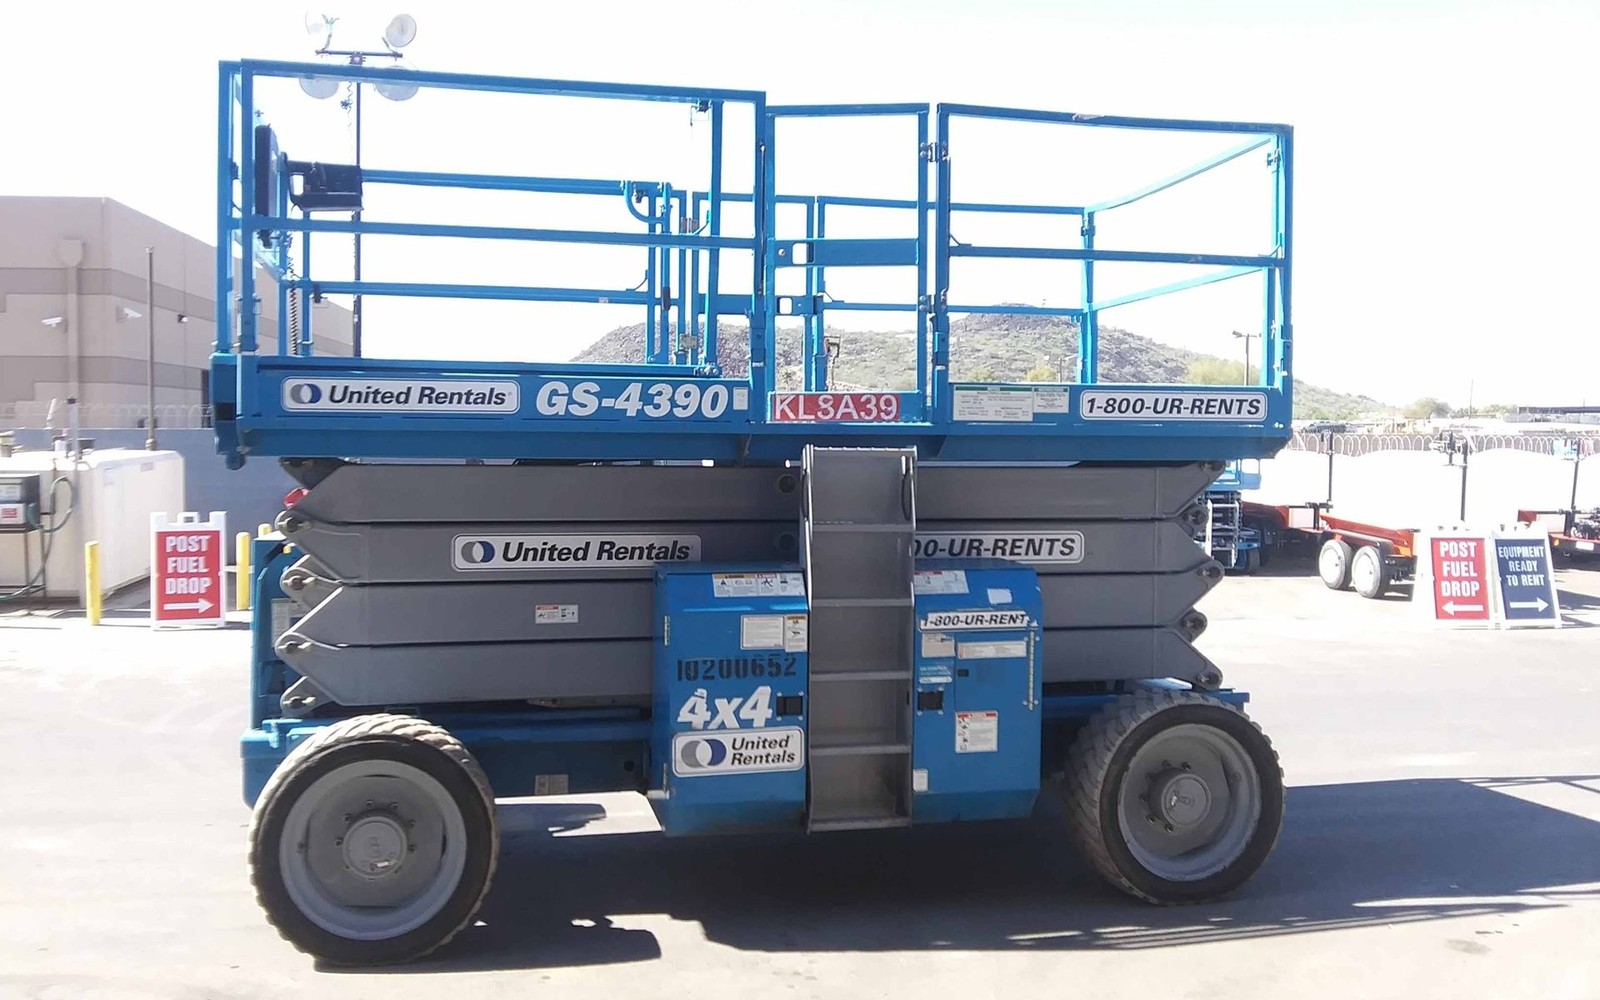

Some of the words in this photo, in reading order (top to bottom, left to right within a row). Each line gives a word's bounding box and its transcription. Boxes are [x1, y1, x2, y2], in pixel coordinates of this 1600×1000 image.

[329, 385, 412, 404] United
[418, 386, 506, 405] Rentals
[536, 381, 729, 419] GS-4390
[775, 394, 898, 420] KL8A39
[1086, 397, 1261, 415] 1-800-UR-RENTS
[165, 535, 211, 552] POST
[502, 541, 591, 562] United
[596, 540, 690, 561] Rentals
[1440, 541, 1477, 558] POST
[1499, 546, 1544, 559] EQUIPMENT
[167, 556, 209, 573] FUEL
[1443, 561, 1477, 577] FUEL
[1508, 560, 1538, 572] READY
[165, 577, 212, 594] DROP
[1441, 580, 1480, 597] DROP
[1506, 575, 1518, 586] TO
[1522, 575, 1544, 586] RENT
[677, 685, 773, 730] 4x4
[731, 735, 790, 751] United
[731, 750, 796, 766] Rentals
